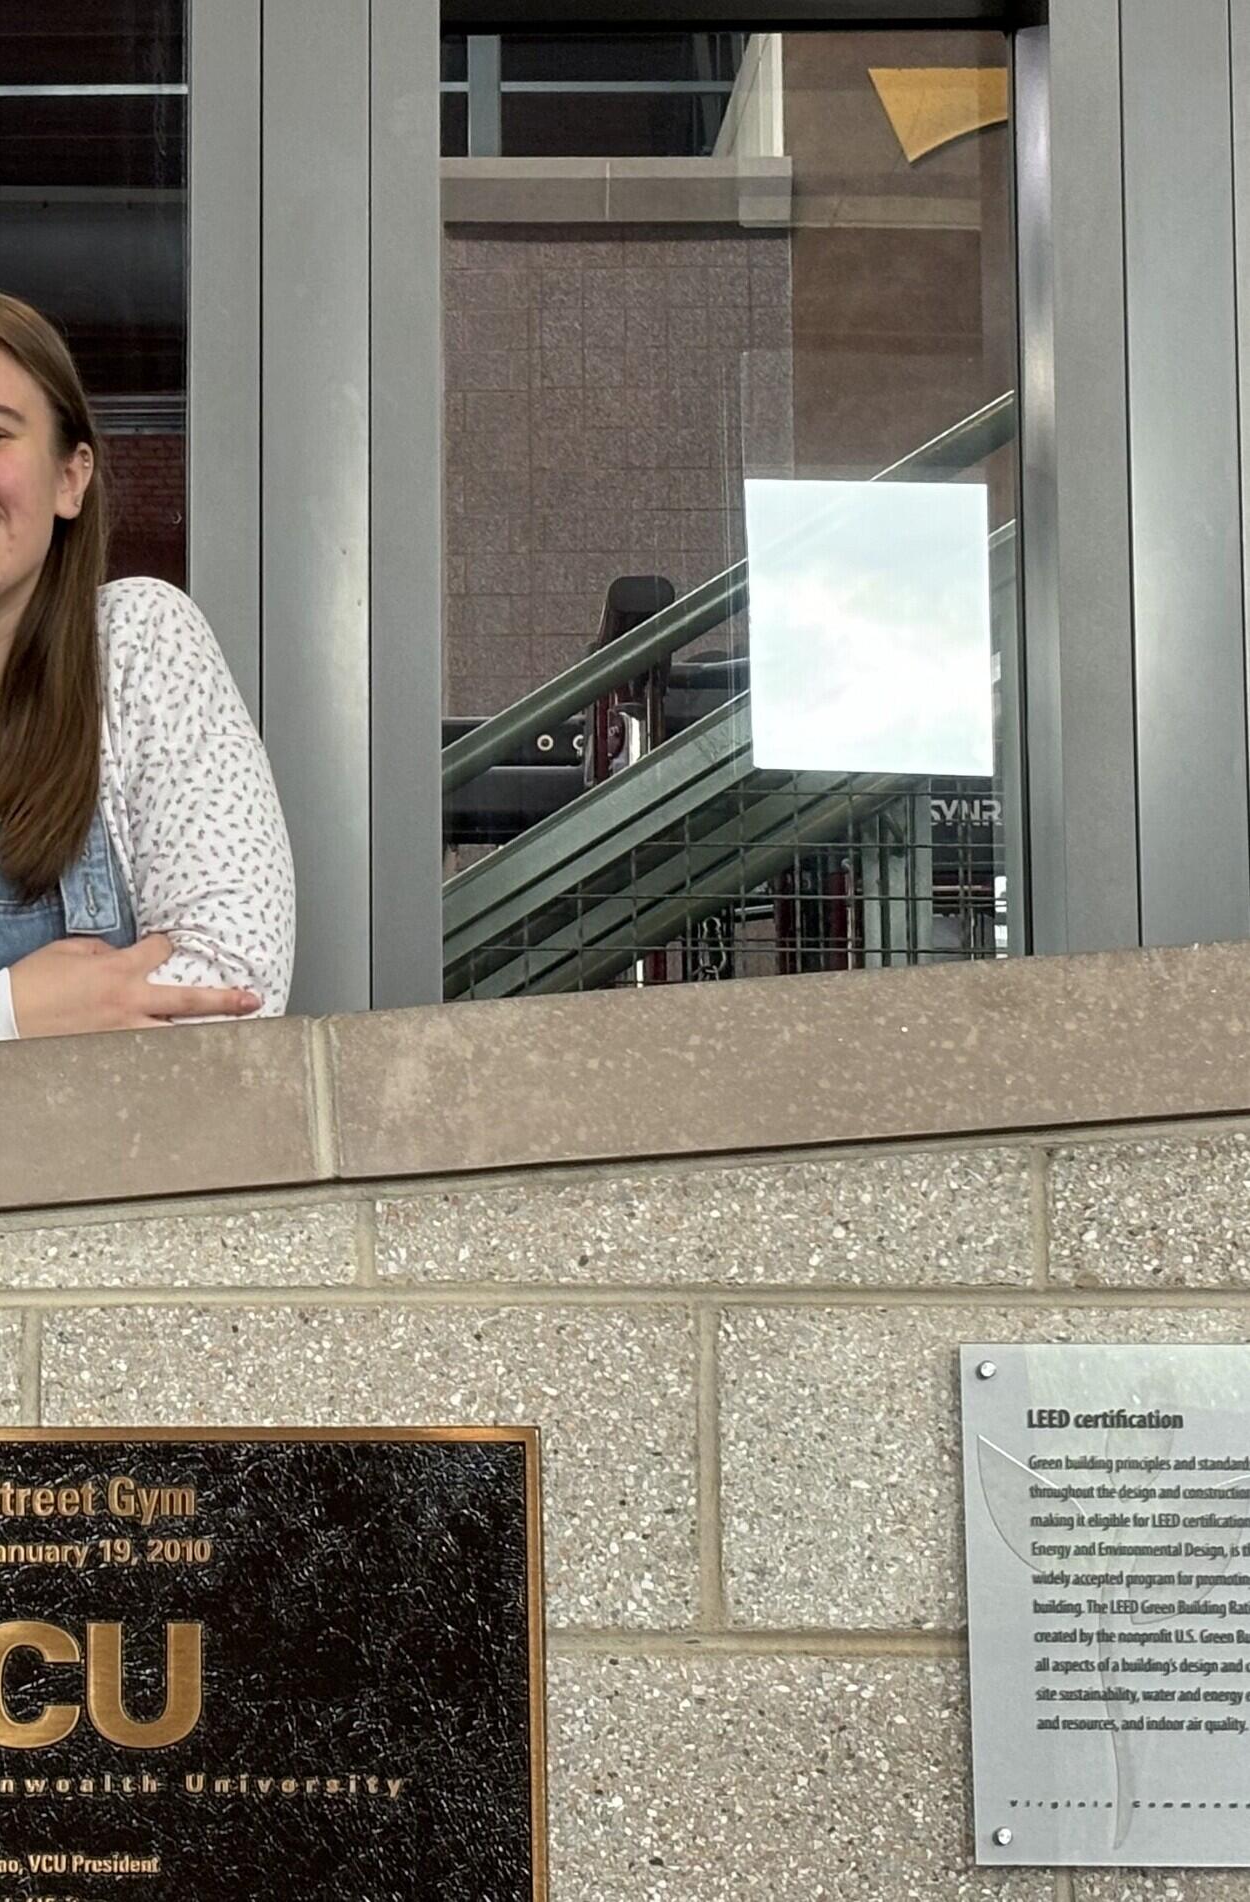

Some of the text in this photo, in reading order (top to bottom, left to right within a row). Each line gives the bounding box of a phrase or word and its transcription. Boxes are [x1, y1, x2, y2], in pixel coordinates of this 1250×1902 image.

[1027, 1409, 1184, 1429] LEED certification
[1028, 1455, 1062, 1470] Green
[1065, 1455, 1113, 1473] building
[1115, 1456, 1172, 1473] principles
[1173, 1456, 1196, 1470] and
[107, 1476, 196, 1526] Gym
[1029, 1485, 1094, 1502] throughout
[1097, 1485, 1116, 1499] the
[1118, 1485, 1156, 1502] design
[1158, 1485, 1180, 1499] and
[1030, 1513, 1074, 1531] making
[1077, 1514, 1086, 1527] it
[1088, 1513, 1130, 1531] eligible
[1132, 1513, 1150, 1528] for
[1152, 1513, 1180, 1528] LEED
[100, 1539, 138, 1567] 19,
[146, 1538, 211, 1564] 2010
[1031, 1541, 1071, 1560] Energy
[1073, 1542, 1096, 1556] and
[1098, 1542, 1182, 1556] Environmental
[1184, 1542, 1228, 1560] Design,
[1230, 1542, 1240, 1557] is
[1032, 1571, 1070, 1588] widely
[1072, 1571, 1123, 1588] accepted
[1125, 1573, 1175, 1589] program
[1177, 1571, 1193, 1585] for
[1033, 1599, 1085, 1617] building.
[1086, 1600, 1108, 1614] The
[1110, 1600, 1138, 1614] LEED
[1141, 1600, 1175, 1614] Green
[1177, 1599, 1226, 1618] Building
[1034, 1628, 1077, 1643] created
[1079, 1629, 1094, 1646] by
[1096, 1629, 1115, 1643] the
[1117, 1629, 1172, 1646] nonprofit
[1175, 1629, 1197, 1643] U.S.
[1200, 1629, 1234, 1643] Green
[1035, 1657, 1050, 1672] all
[1052, 1659, 1095, 1674] aspects
[1097, 1657, 1110, 1672] of
[1111, 1661, 1120, 1672] a
[1121, 1657, 1177, 1676] building's
[1179, 1657, 1218, 1676] design
[1220, 1657, 1243, 1672] and
[1035, 1686, 1057, 1701] site
[1058, 1686, 1140, 1705] sustainability,
[1142, 1687, 1176, 1701] water
[1177, 1687, 1201, 1701] and
[1203, 1689, 1244, 1705] energy
[1036, 1716, 1249, 1734] and resources, and indoor air quality.
[185, 1773, 403, 1798] University
[28, 1854, 67, 1874] VCU
[72, 1852, 160, 1874] President
